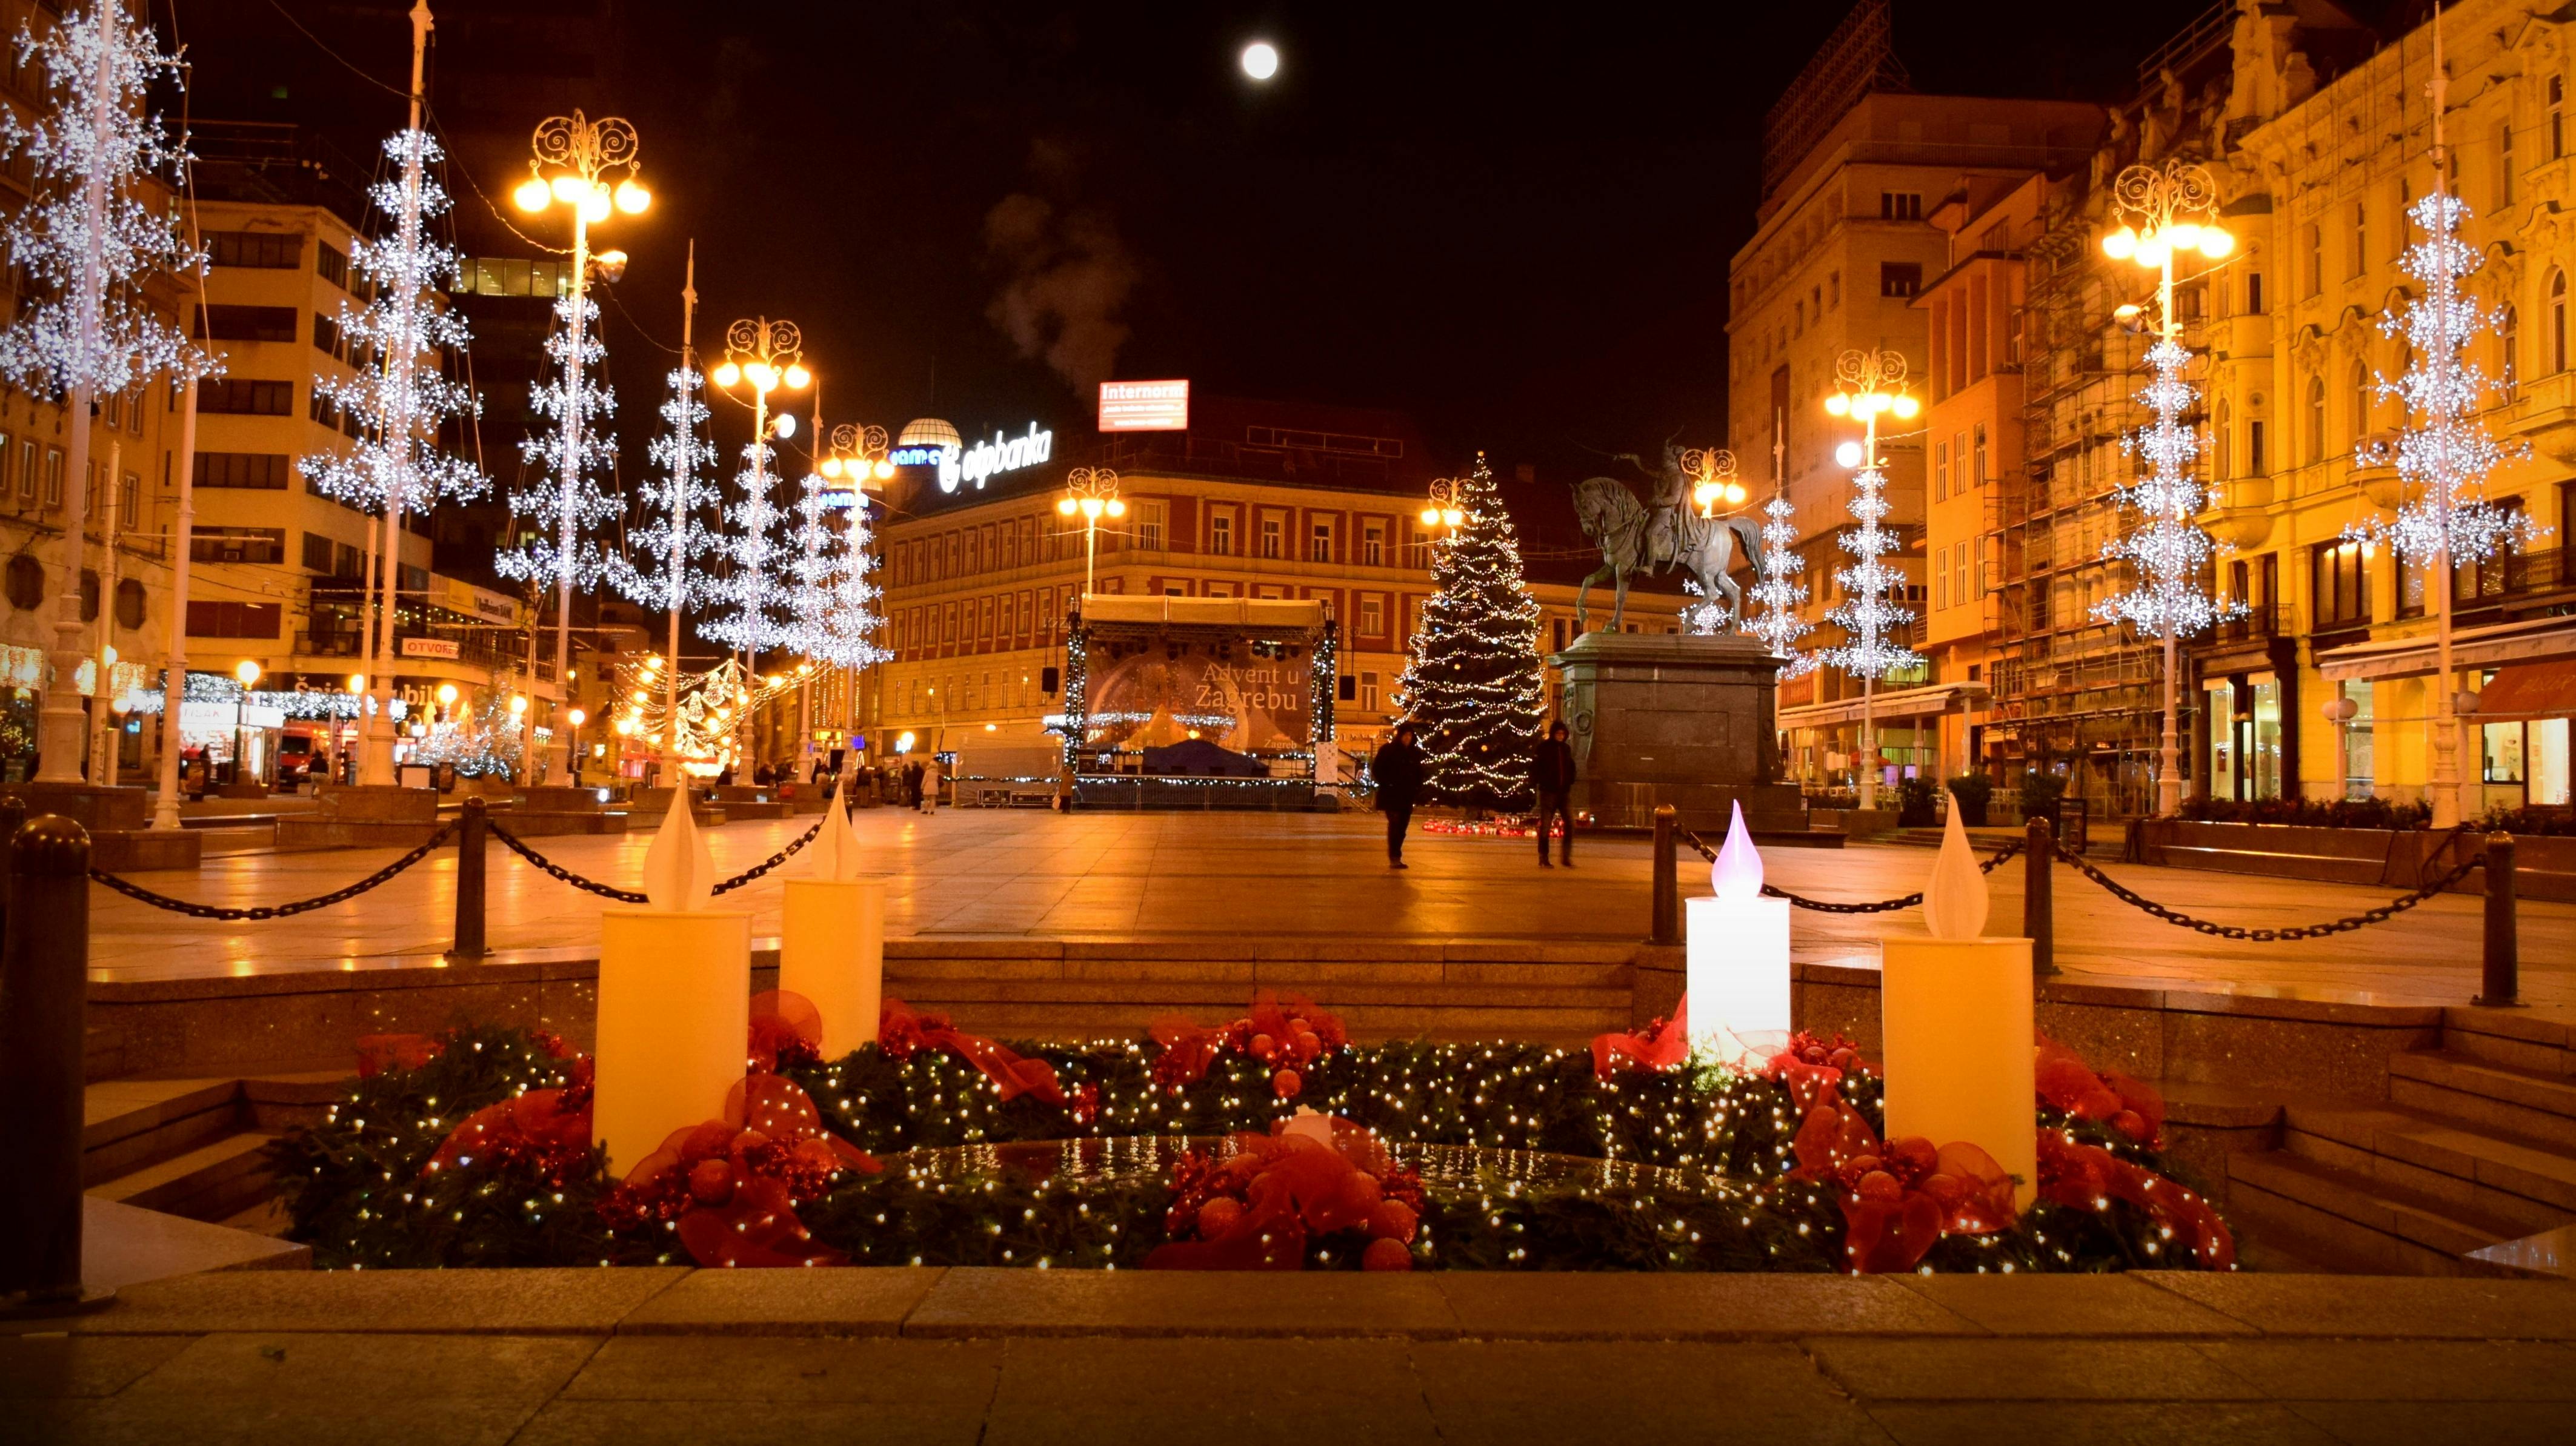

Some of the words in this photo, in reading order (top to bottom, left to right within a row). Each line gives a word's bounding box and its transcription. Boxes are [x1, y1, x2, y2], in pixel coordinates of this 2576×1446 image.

[1102, 384, 1184, 400] Internorm
[1201, 662, 1280, 684] Advent
[1288, 670, 1299, 685] u
[1195, 685, 1297, 715] Zagrebu
[1263, 738, 1297, 750] Zagreb
